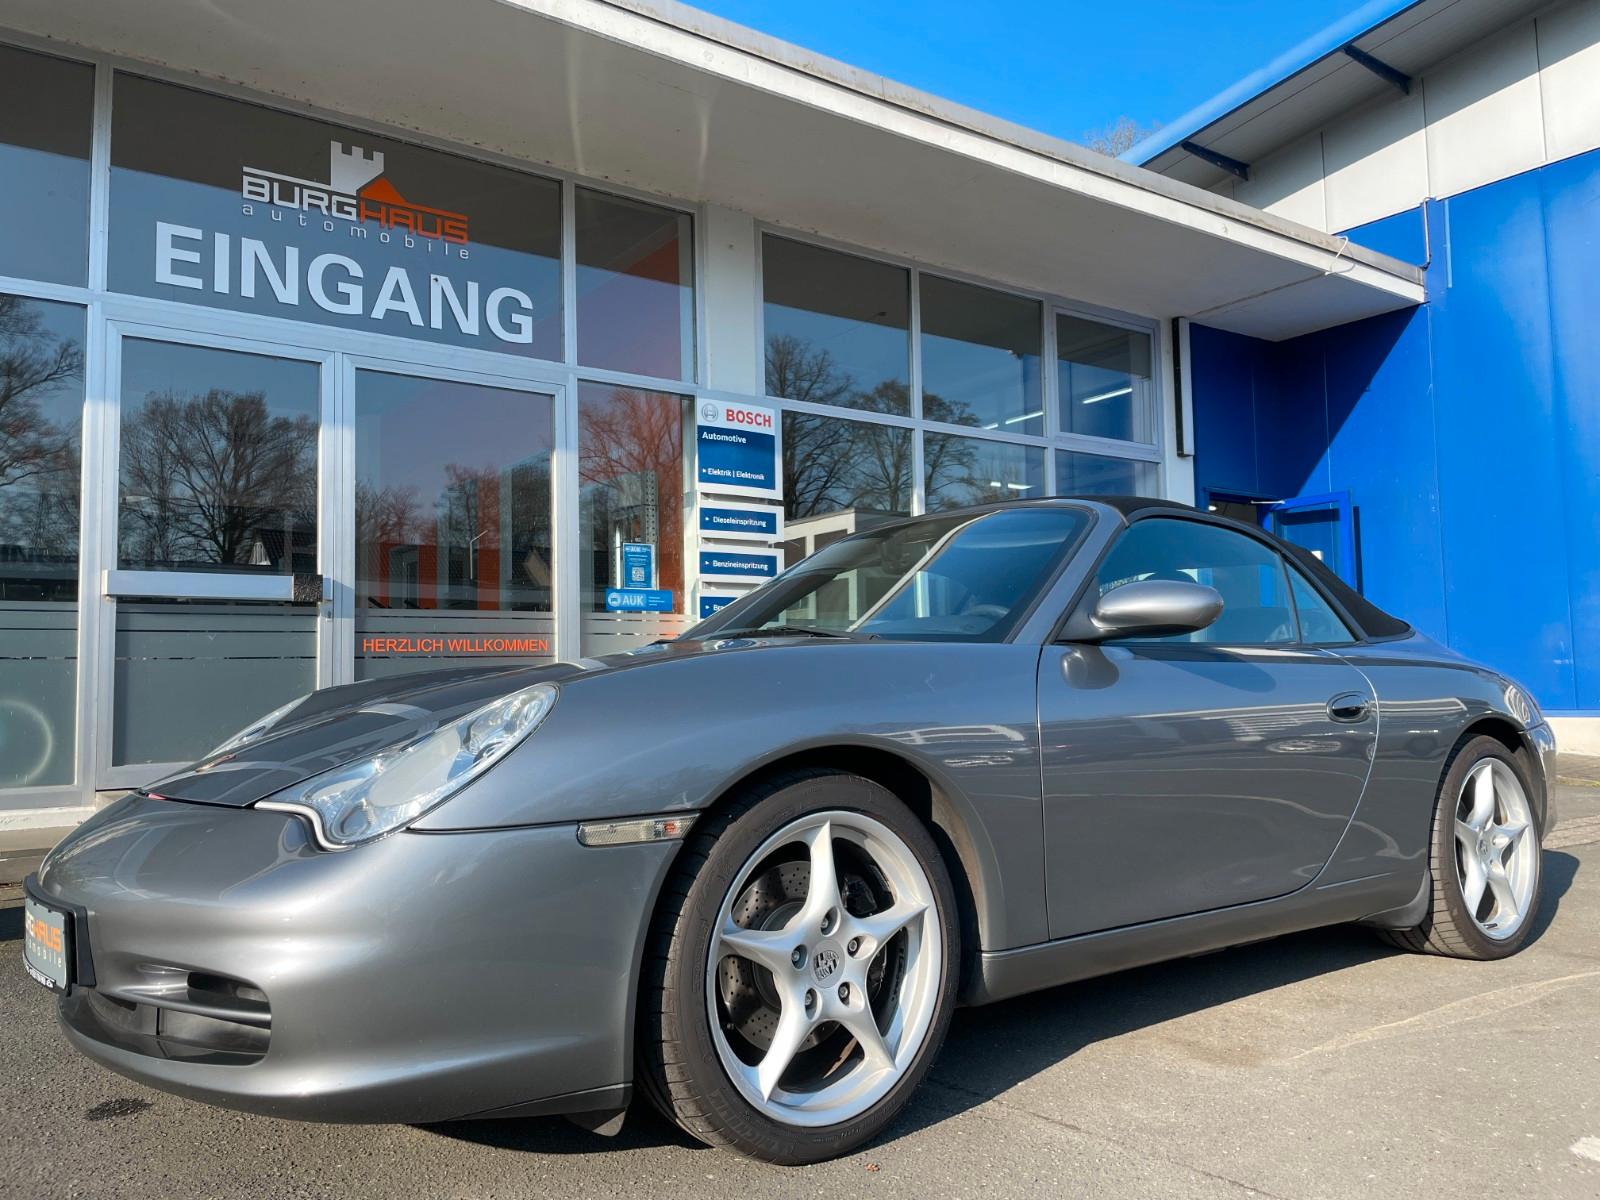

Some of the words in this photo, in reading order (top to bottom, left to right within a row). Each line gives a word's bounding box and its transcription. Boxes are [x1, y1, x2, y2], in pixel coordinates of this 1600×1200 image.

[242, 174, 469, 245] BURGHAUS
[242, 201, 470, 260] automobile
[155, 221, 534, 344] EINGANG
[725, 408, 772, 428] BOSCH
[702, 431, 747, 444] Automotive
[707, 467, 732, 477] Elektrik
[736, 470, 765, 481] Elektronik
[712, 516, 767, 528] Dieseleinspritzung
[712, 559, 769, 571] Benzineinspritzung
[622, 594, 644, 607] AUK
[362, 638, 444, 653] HERZLICH
[447, 638, 549, 653] WILLKOMMEN
